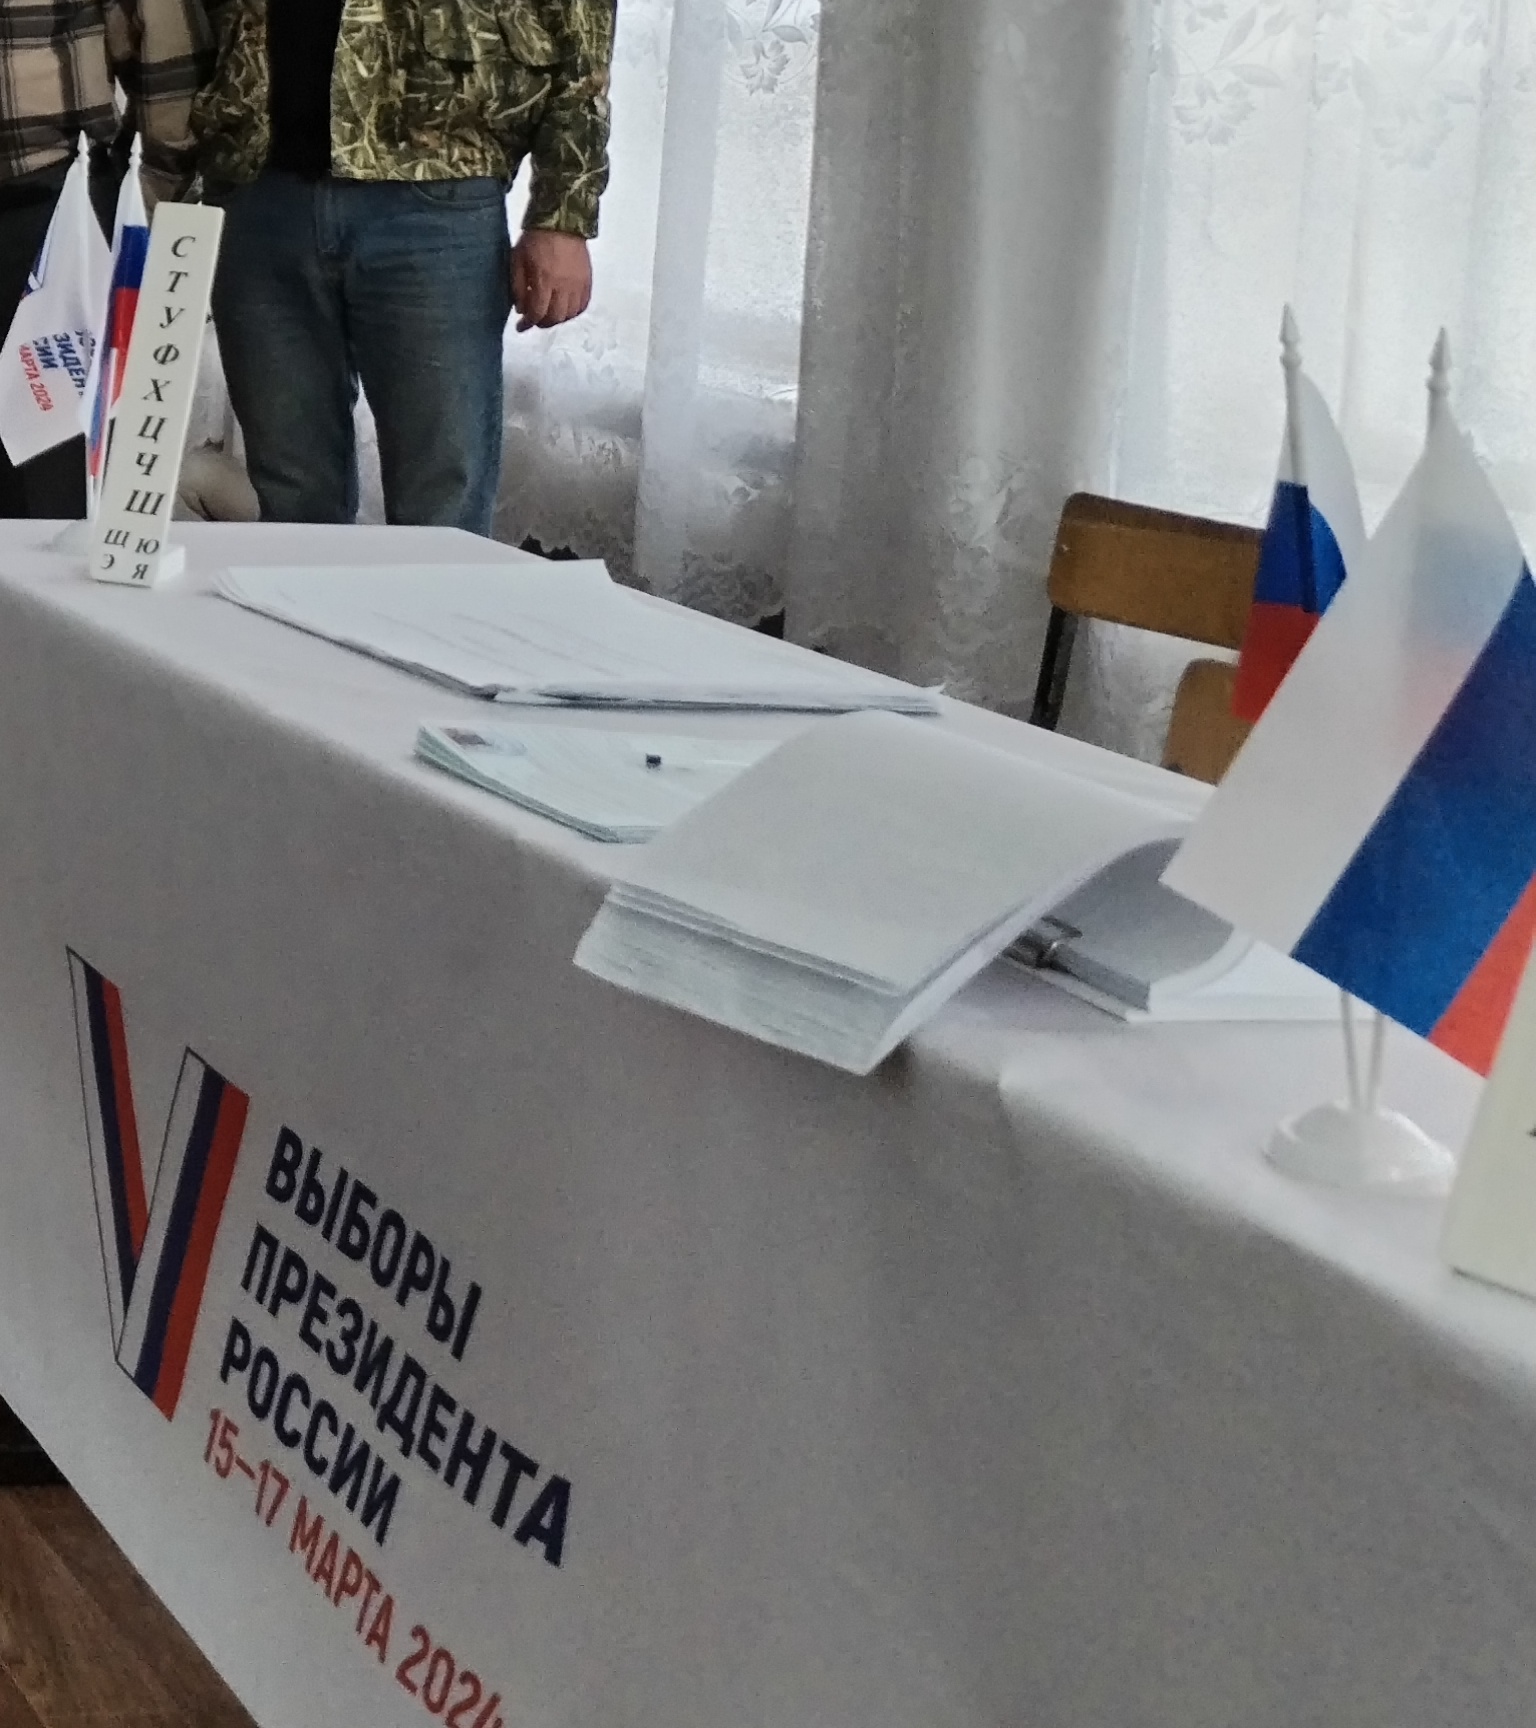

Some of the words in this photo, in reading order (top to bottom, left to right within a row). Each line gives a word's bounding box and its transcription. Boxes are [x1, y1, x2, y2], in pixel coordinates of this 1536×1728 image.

[53, 332, 85, 398] ЗИДЕН
[264, 1125, 483, 1362] ВЫБОРЫ
[219, 1316, 402, 1547] РОССИИ
[240, 1221, 572, 1568] ПРЕЗИДЕНТА
[288, 1494, 395, 1664] МАРТА
